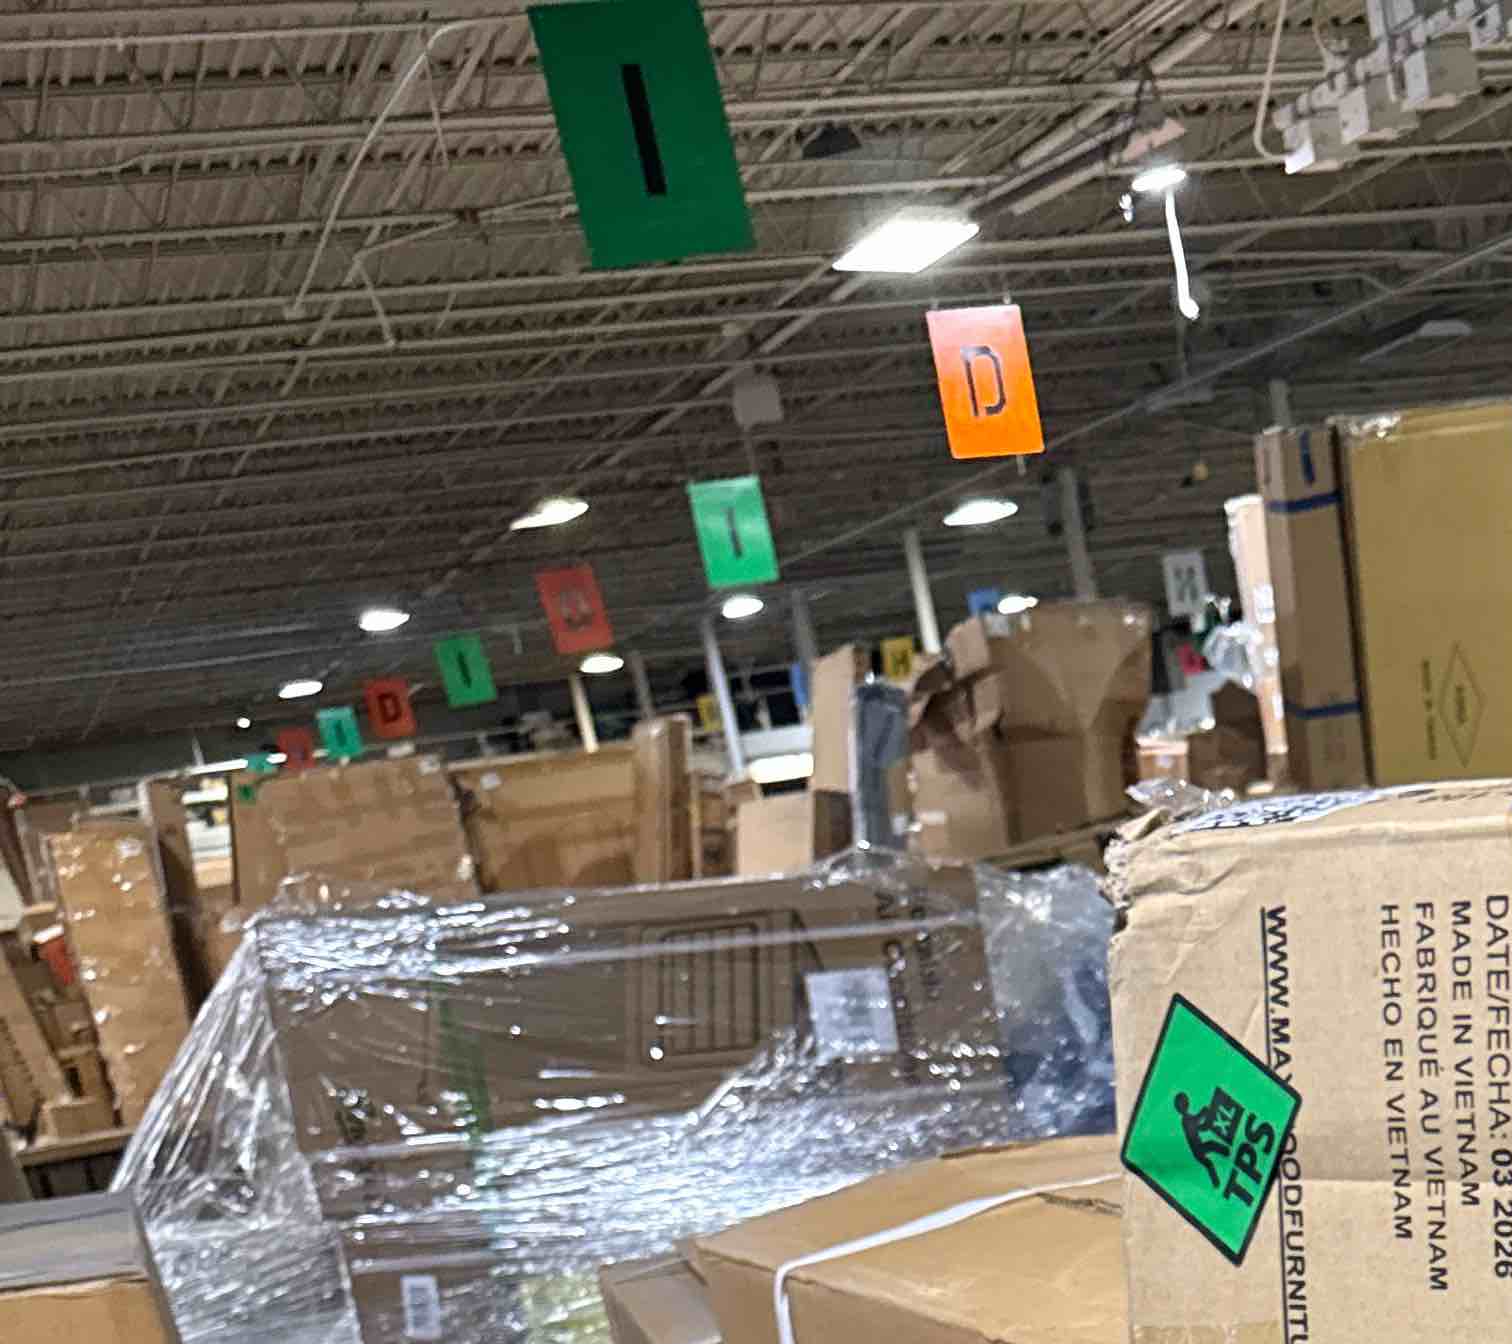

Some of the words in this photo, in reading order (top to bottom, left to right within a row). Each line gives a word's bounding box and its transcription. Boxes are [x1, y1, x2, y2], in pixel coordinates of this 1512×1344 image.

[958, 344, 1004, 418] D
[1380, 904, 1402, 1028] HECHO
[1415, 901, 1441, 1079] FABRIQUÉ
[1452, 901, 1474, 999] MADE
[1384, 1039, 1404, 1081] EN
[1454, 1014, 1474, 1040] IN
[1486, 895, 1512, 1139] DATE/FECHA:
[1222, 1112, 1276, 1208] TPS
[1385, 1093, 1412, 1240] VIETNAM
[1420, 1090, 1439, 1135] AU
[1454, 1052, 1480, 1206] VIETNAM
[1423, 1146, 1448, 1291] VIETNAM
